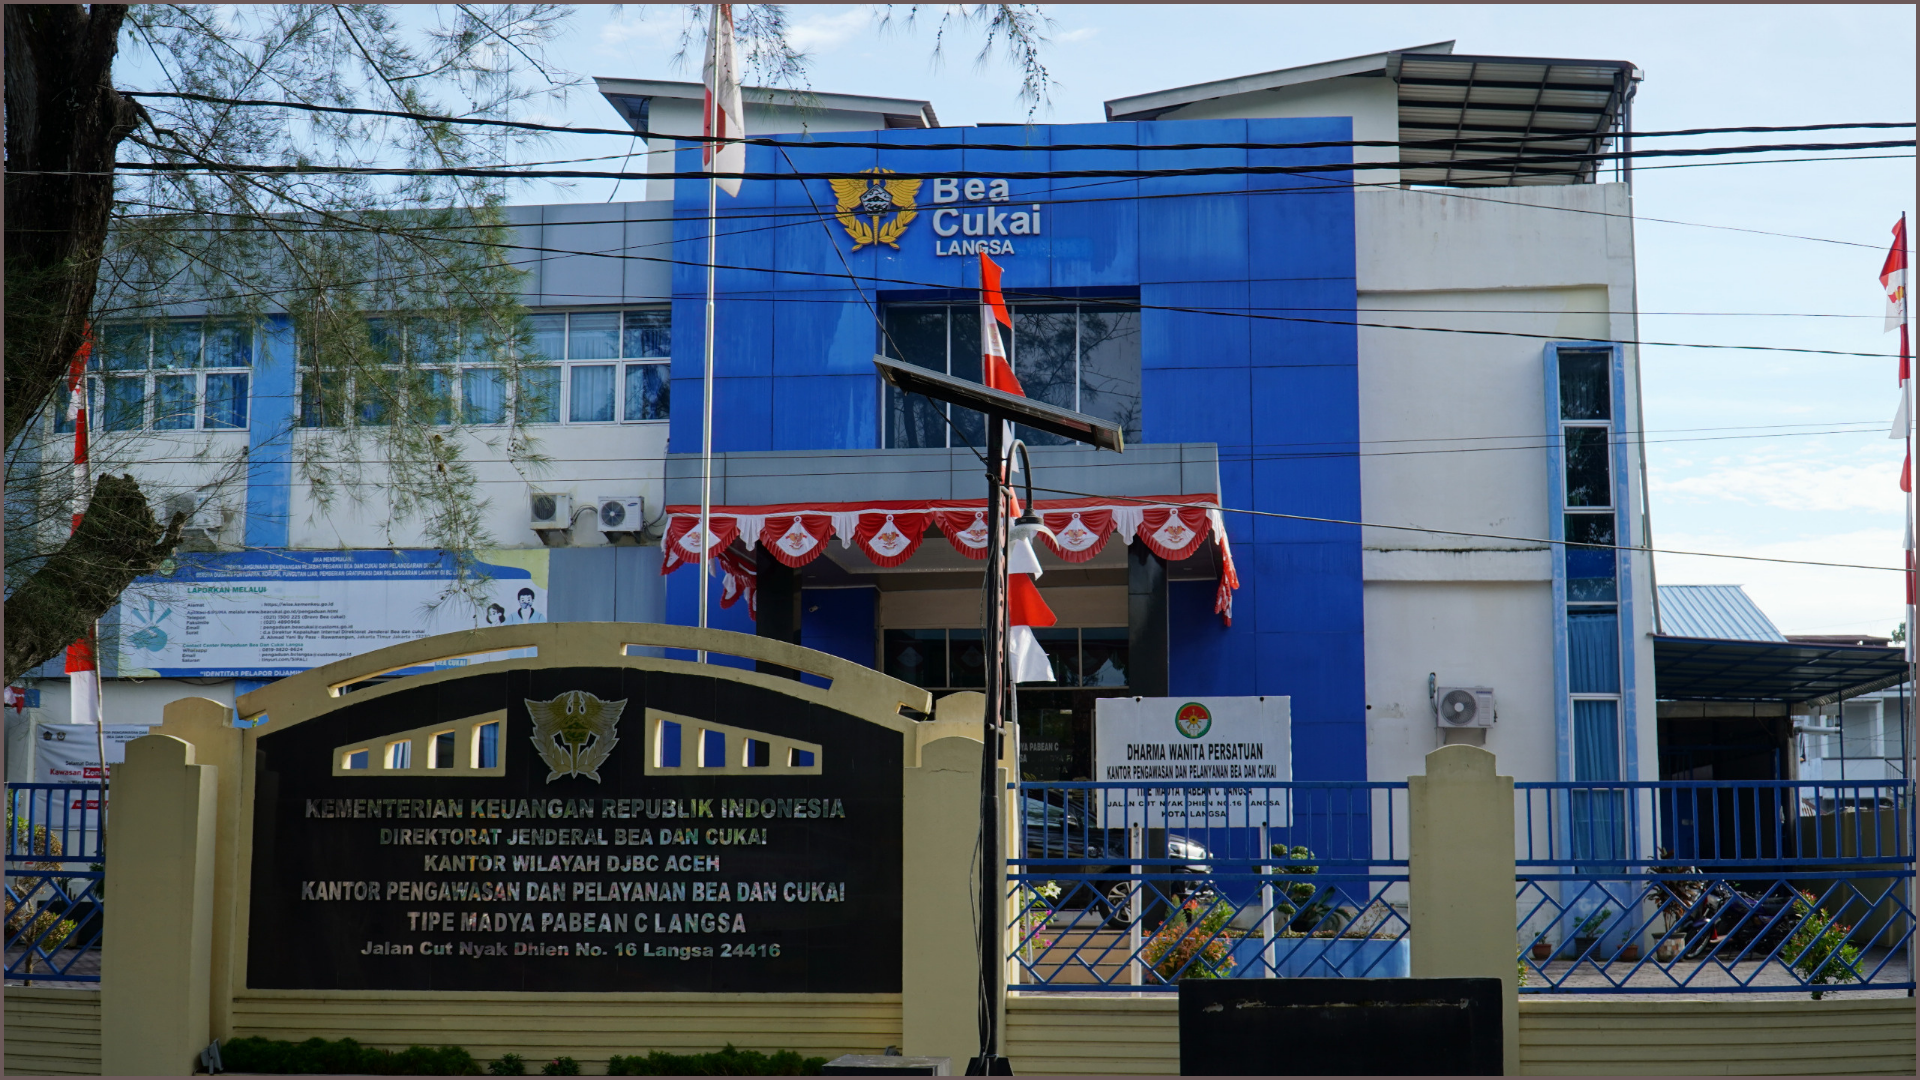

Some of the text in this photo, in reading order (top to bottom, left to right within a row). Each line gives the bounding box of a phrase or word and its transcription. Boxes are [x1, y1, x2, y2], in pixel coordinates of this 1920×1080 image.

[933, 177, 1010, 203] Bea
[932, 204, 1041, 237] Cukai
[936, 239, 1015, 256] LANGSA
[1029, 742, 1053, 751] PABEAN
[1054, 741, 1060, 751] C
[1127, 743, 1263, 761] DHARMA WANITA PERSATUAN
[50, 768, 81, 776] Kawasan
[1107, 765, 1277, 780] KANTOR PENGAWASAN DAN PELANYANAN BEA DAN CUKAI
[305, 798, 846, 819] KEMENTERIAN KEUANGAN REPUBLIK INDONESIA
[1190, 810, 1226, 818] LANGSA
[379, 828, 768, 846] DIREKTORAT JENDERAL BEA DAN CUKAI
[424, 855, 720, 872] KANTOR WILAYAH DJBC ACEH
[301, 881, 845, 902] KANTOR PENGAWASAN DAN PELAYANAN BEA DAN CUKAI
[407, 911, 746, 933] TIPE MADYA PABEAN C LANGSA
[361, 941, 781, 961] Jalan Cut Nyak Dhien No. 16 Langsa 24416
